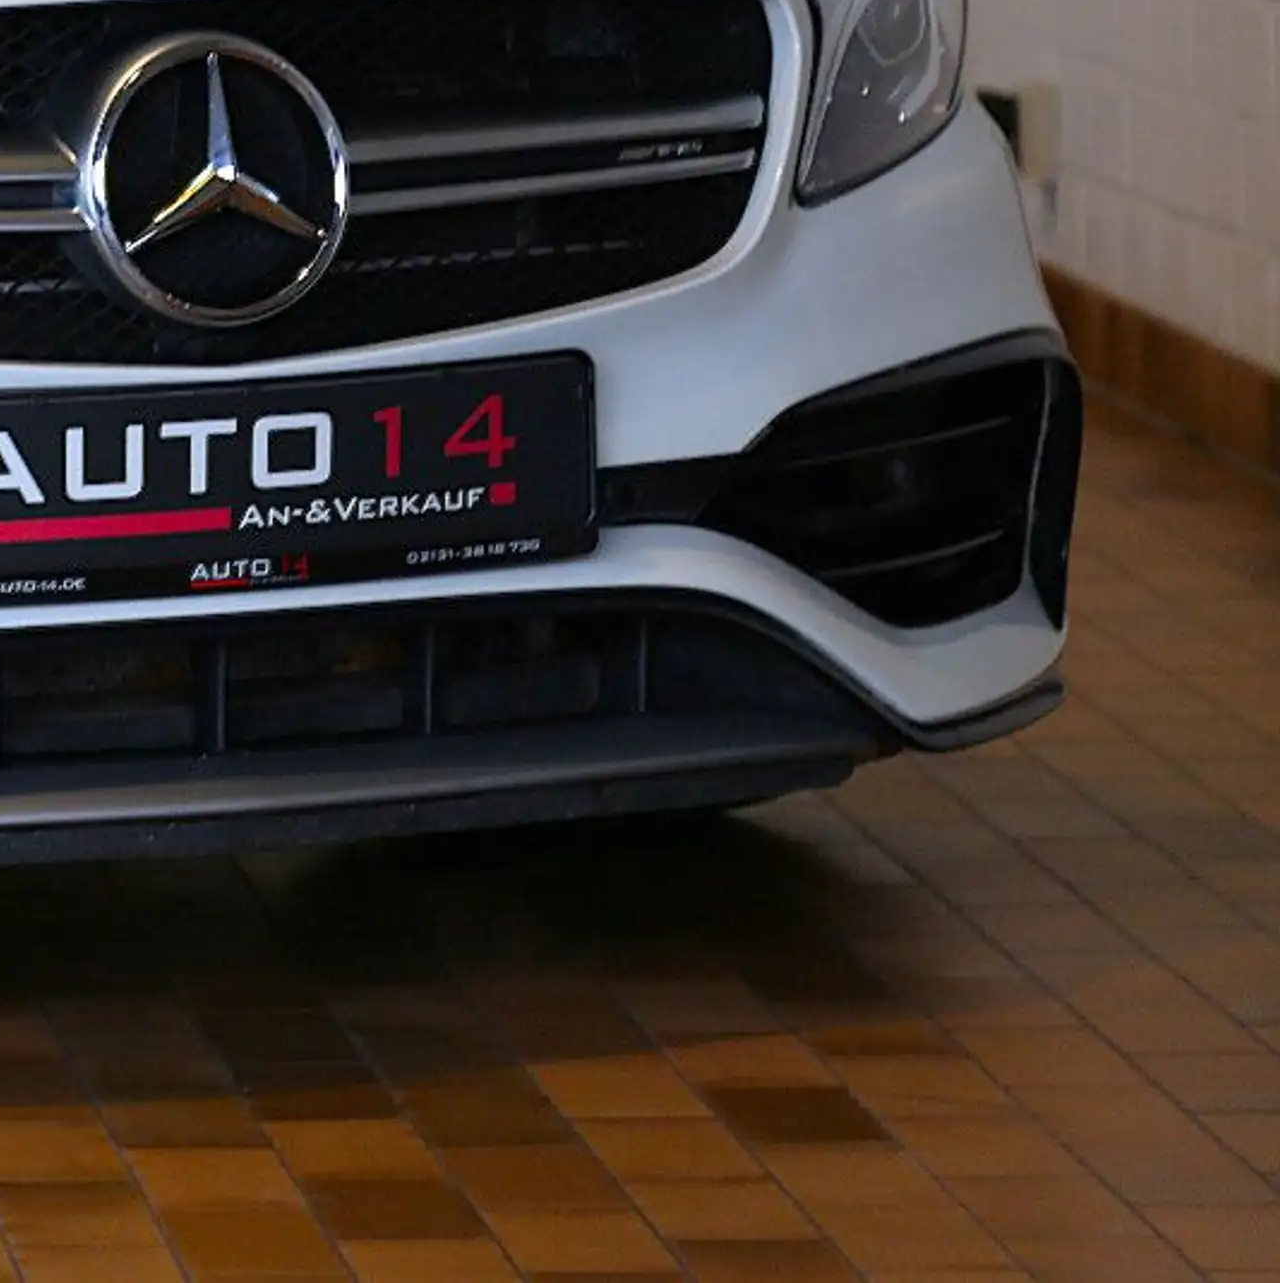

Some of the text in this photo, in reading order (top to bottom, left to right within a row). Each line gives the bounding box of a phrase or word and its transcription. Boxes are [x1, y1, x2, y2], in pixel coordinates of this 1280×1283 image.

[373, 393, 517, 479] 14
[238, 485, 486, 530] AN-&VERKAUF
[189, 558, 272, 582] AUTO
